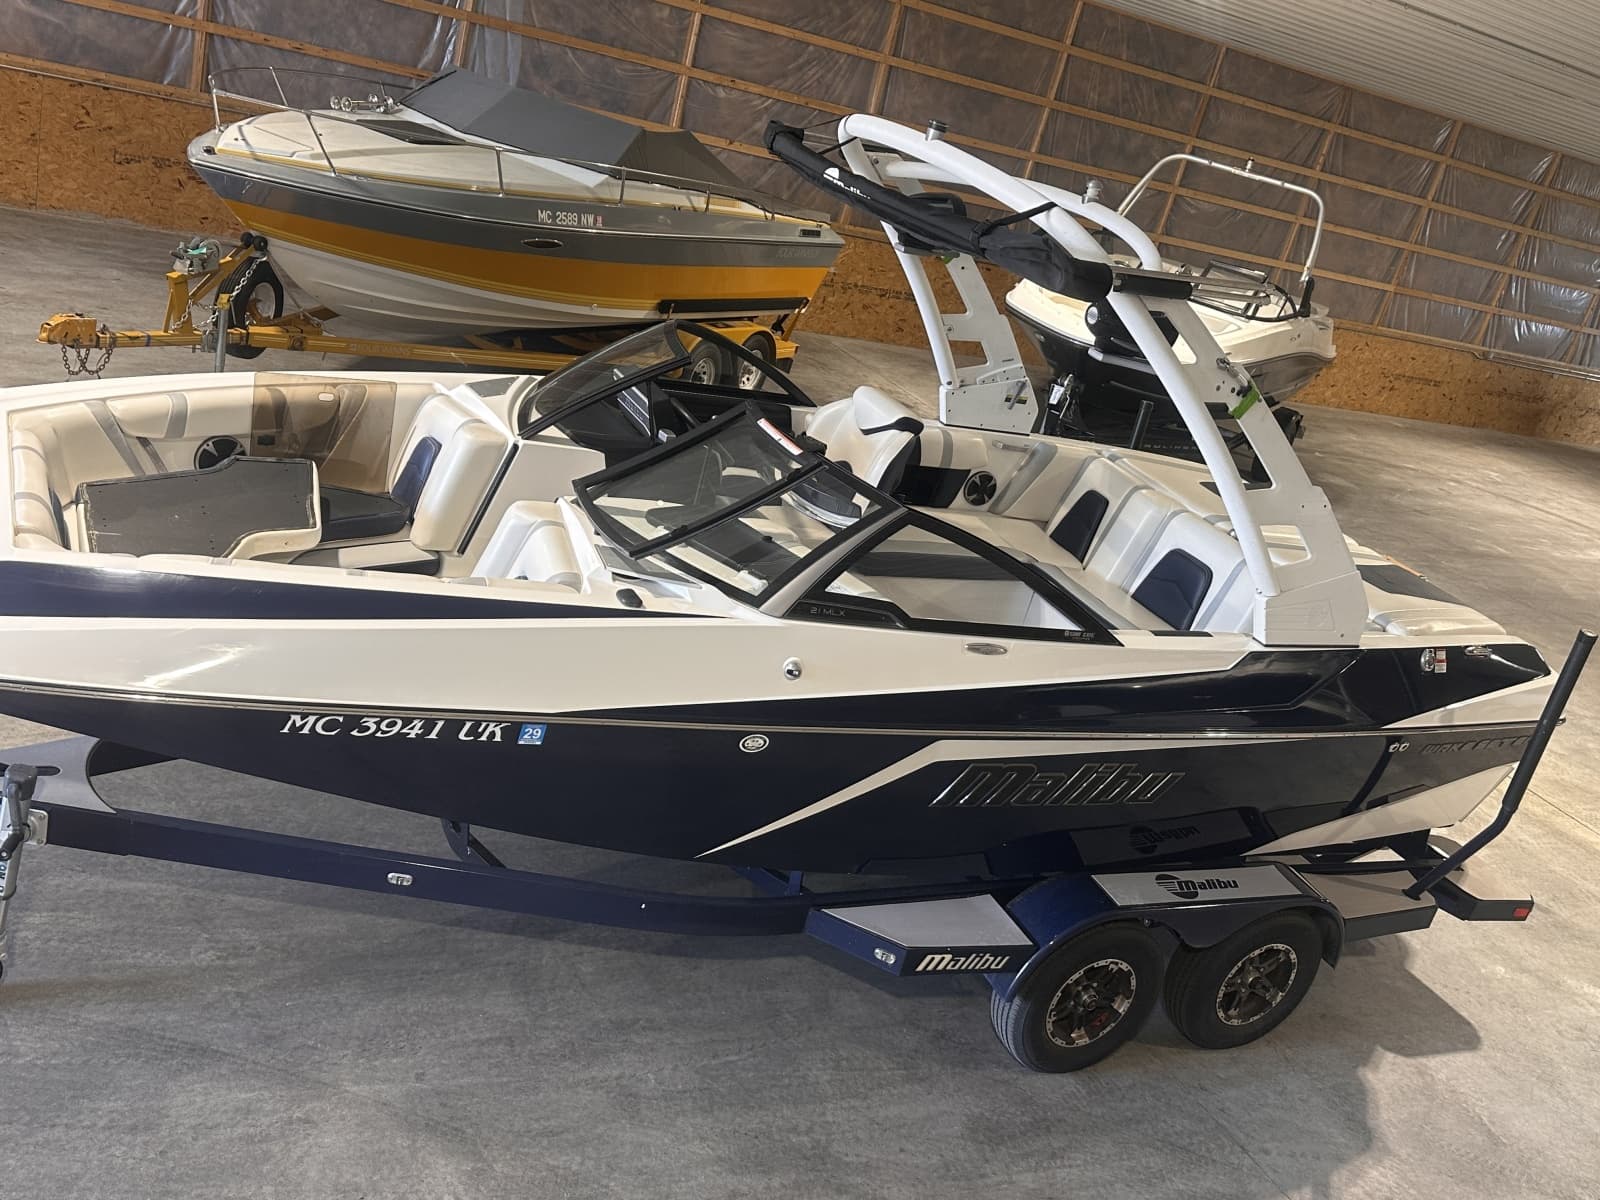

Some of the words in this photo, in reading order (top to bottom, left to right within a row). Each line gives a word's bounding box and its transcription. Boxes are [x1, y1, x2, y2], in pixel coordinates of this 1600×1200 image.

[537, 209, 552, 223] MC
[556, 211, 578, 225] 2589
[581, 213, 595, 227] NW
[280, 714, 344, 736] MC
[350, 717, 447, 739] 3941
[458, 720, 511, 742] UK
[522, 727, 542, 739] 29
[928, 763, 1185, 807] Malibu
